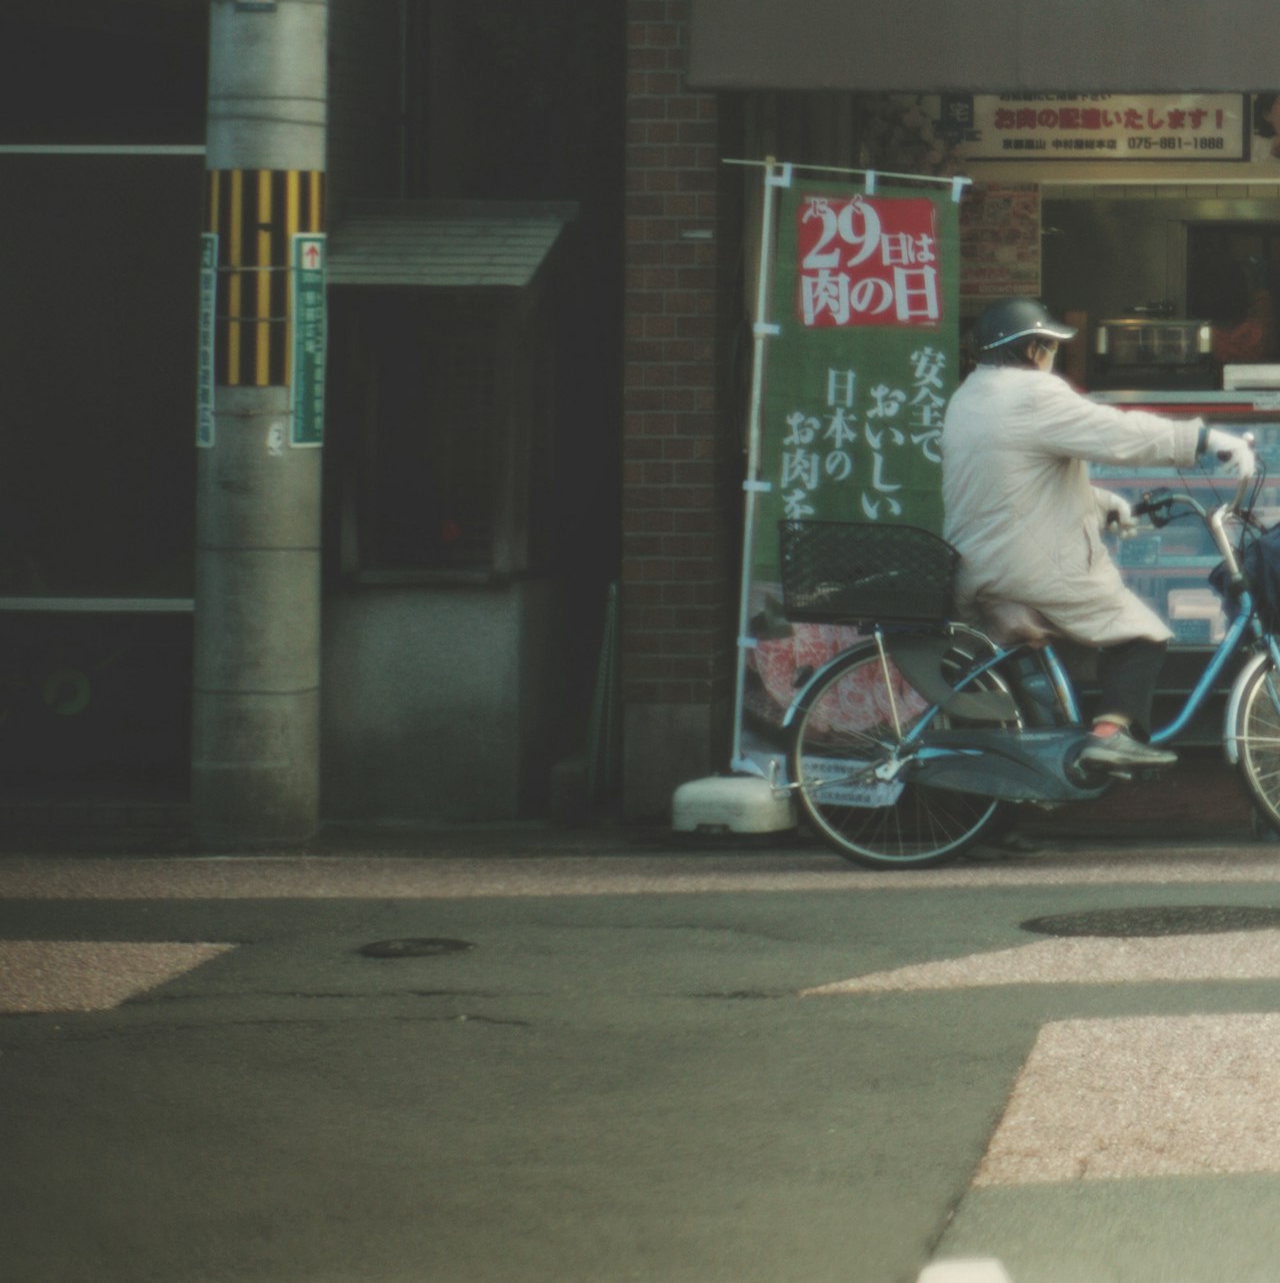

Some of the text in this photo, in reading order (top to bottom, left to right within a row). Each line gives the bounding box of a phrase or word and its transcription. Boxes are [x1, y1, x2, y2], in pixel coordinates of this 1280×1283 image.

[802, 201, 936, 269] 29日は
[801, 265, 940, 327] 肉の日
[823, 367, 858, 482] 日本の
[861, 382, 907, 520] おいしい
